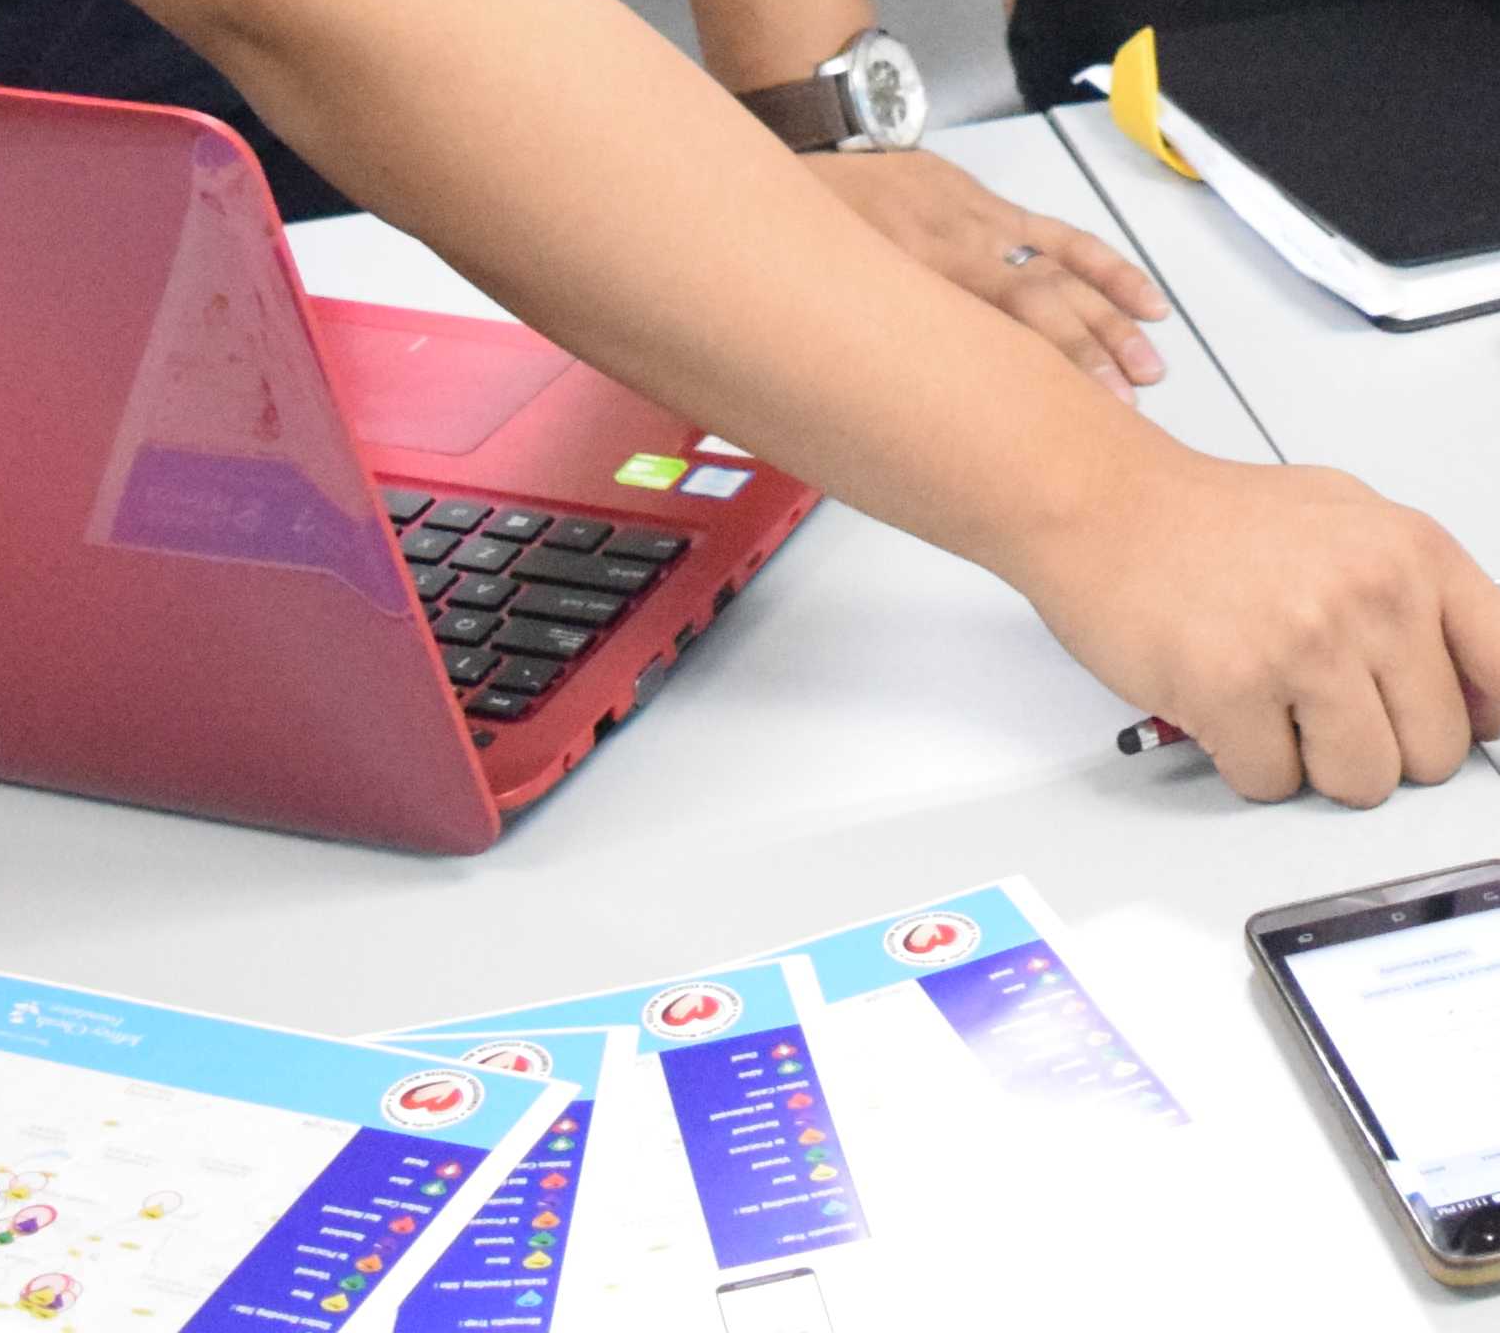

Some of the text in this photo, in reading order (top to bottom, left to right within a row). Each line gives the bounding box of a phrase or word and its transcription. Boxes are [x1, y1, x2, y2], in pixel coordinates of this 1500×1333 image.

[455, 619, 477, 631] Q
[1436, 1195, 1489, 1217] 11:14 PM
